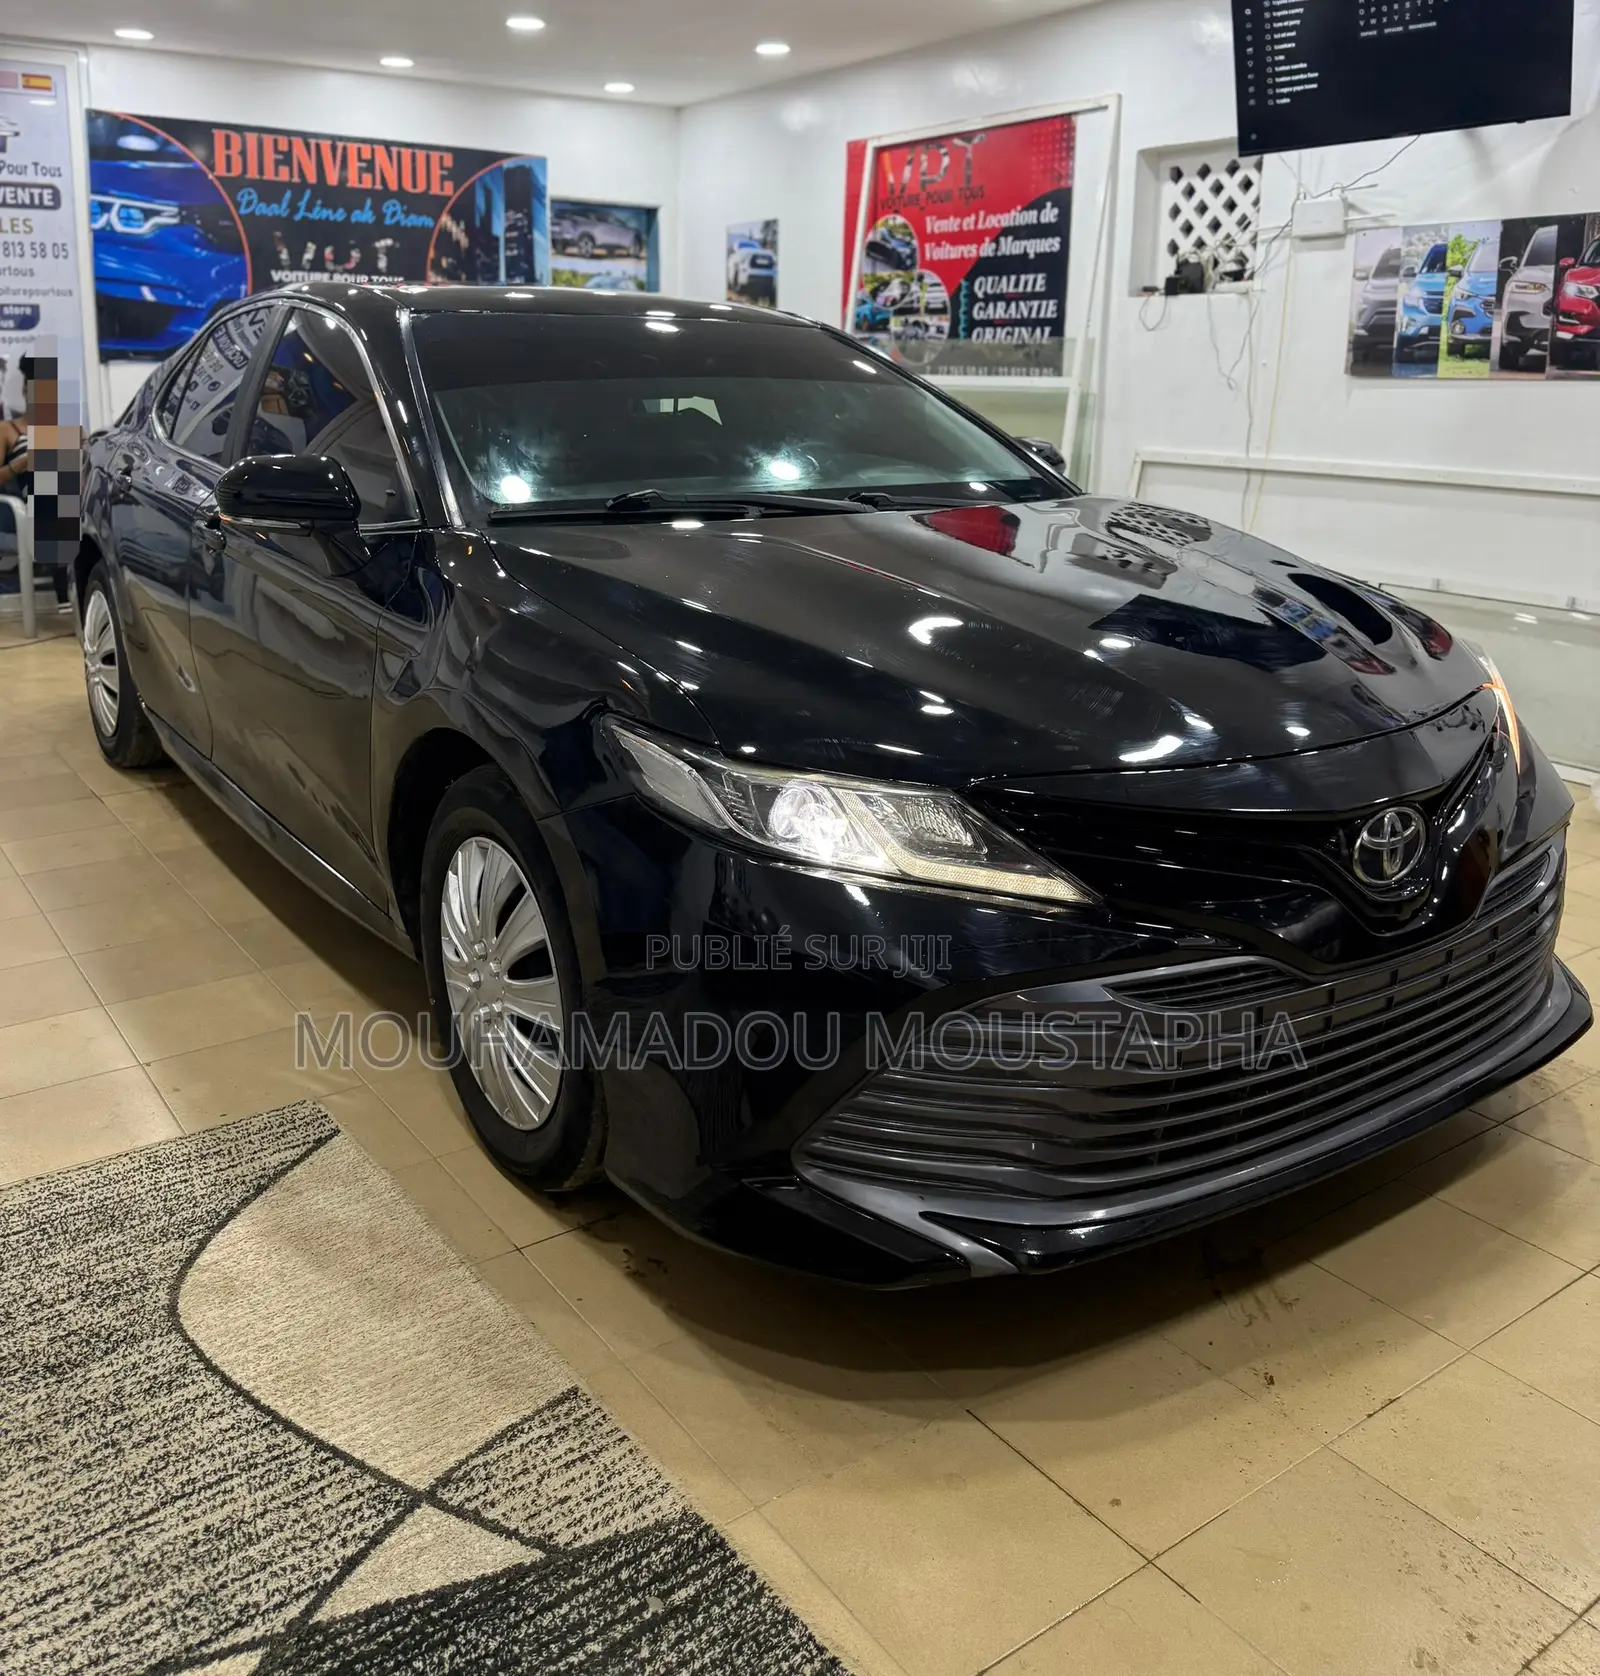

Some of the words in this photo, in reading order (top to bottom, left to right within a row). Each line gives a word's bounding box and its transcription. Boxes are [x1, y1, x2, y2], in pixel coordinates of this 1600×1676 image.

[31, 161, 62, 177] Tous
[211, 128, 454, 196] BIENVENUE
[925, 215, 961, 235] Vente
[962, 213, 976, 232] et
[976, 205, 1038, 230] Location
[1039, 201, 1060, 225] de
[2, 240, 25, 259] 813
[30, 241, 48, 259] 58
[51, 241, 70, 260] 05
[924, 240, 978, 261] Voitures
[979, 236, 997, 258] de
[997, 236, 1062, 260] Marques
[973, 273, 1047, 299] QUALITE
[972, 299, 1058, 320] GARANTIE
[971, 326, 1052, 345] ORIGINAL
